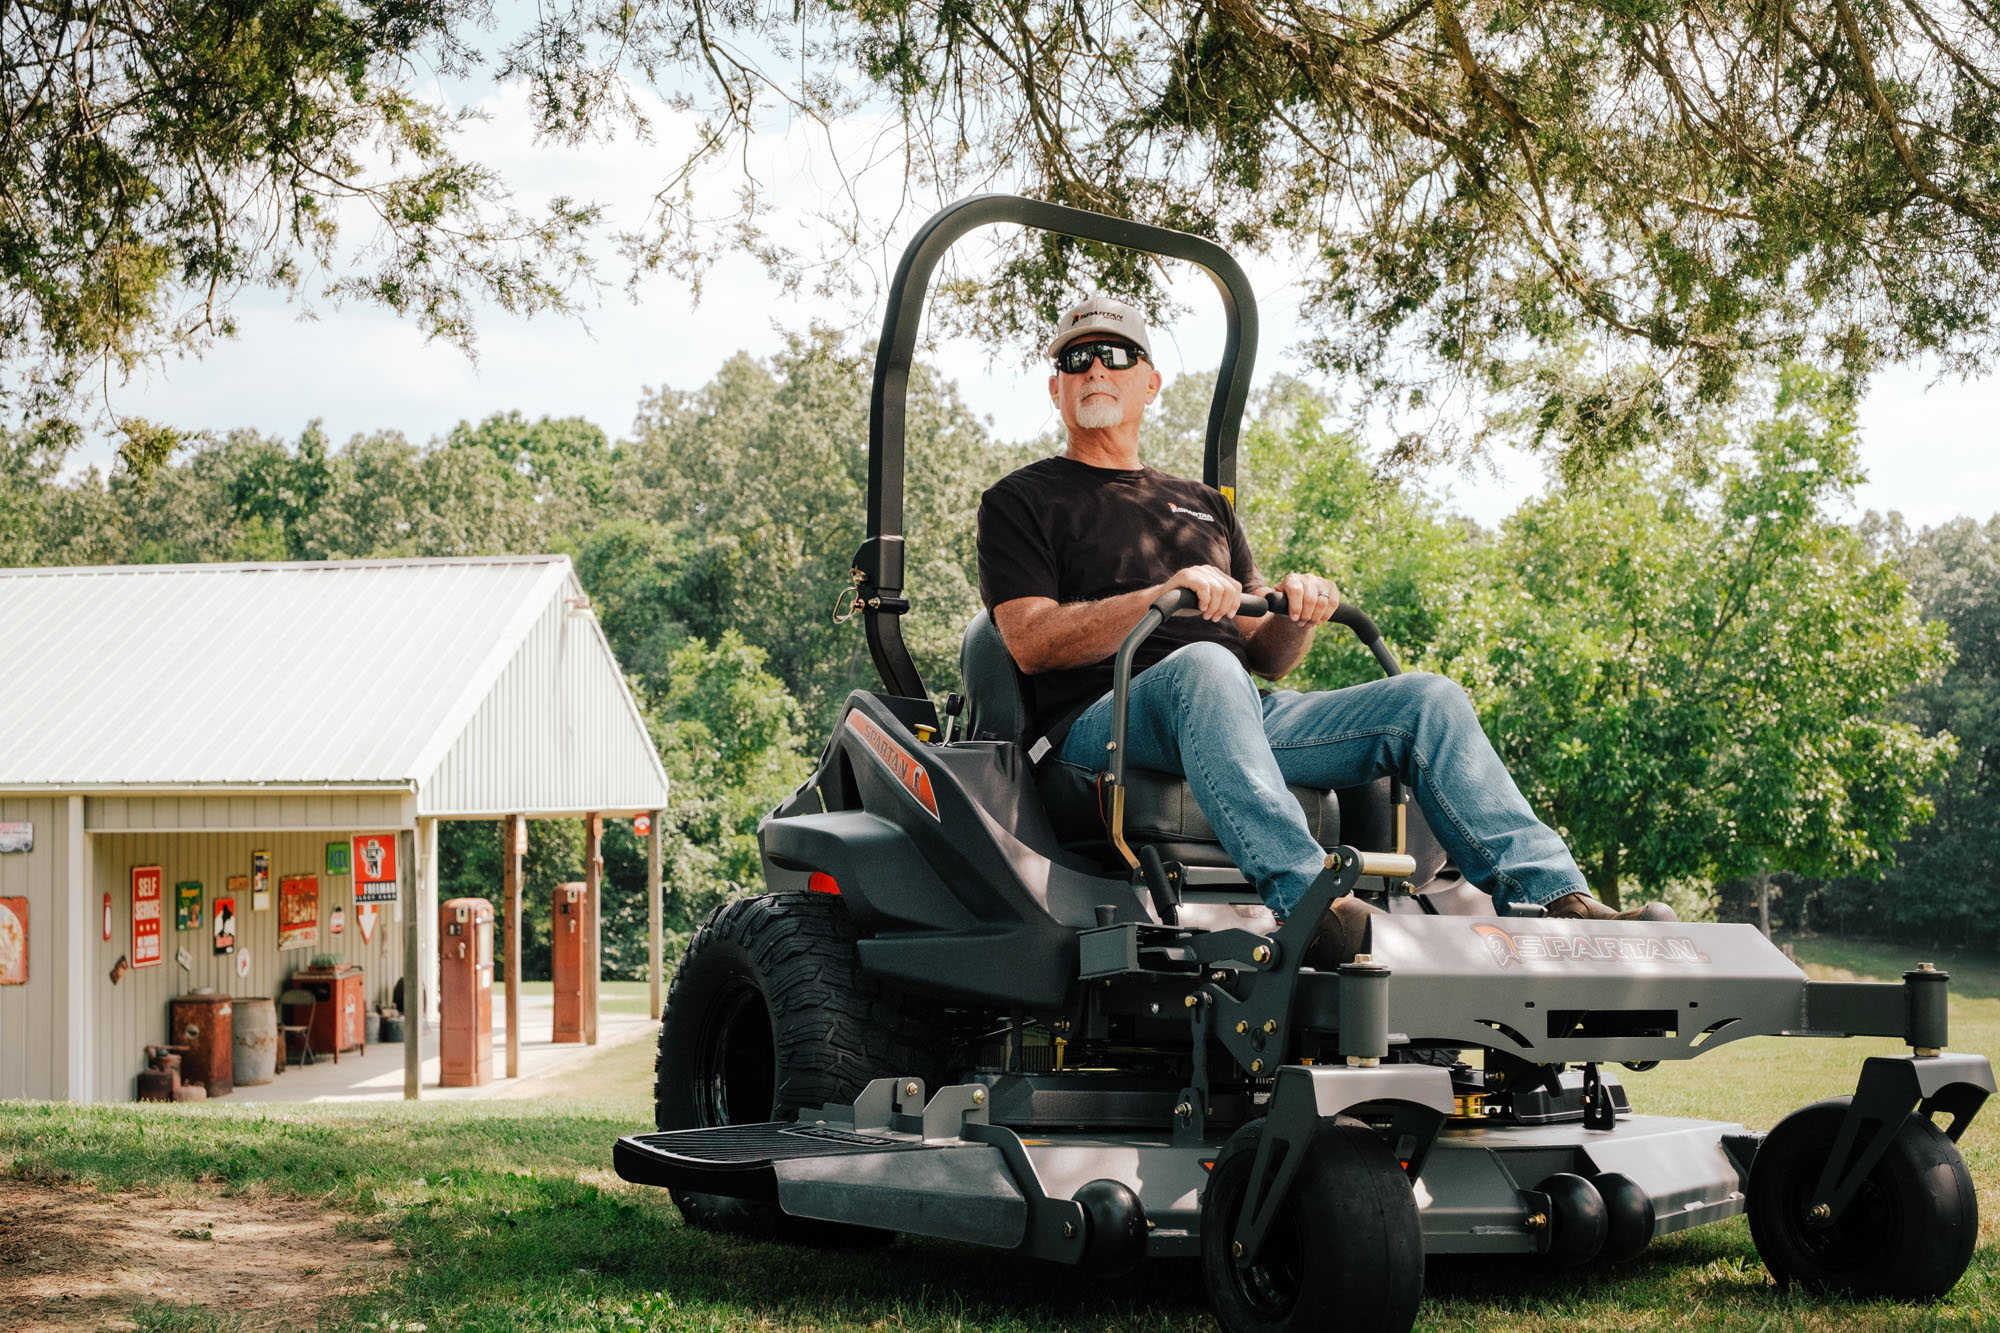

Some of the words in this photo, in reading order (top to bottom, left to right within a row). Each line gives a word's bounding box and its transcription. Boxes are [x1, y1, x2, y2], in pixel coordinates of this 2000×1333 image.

[864, 724, 909, 780] SPARTAN
[138, 876, 157, 897] SELF
[1511, 934, 1700, 962] SPARTAN
